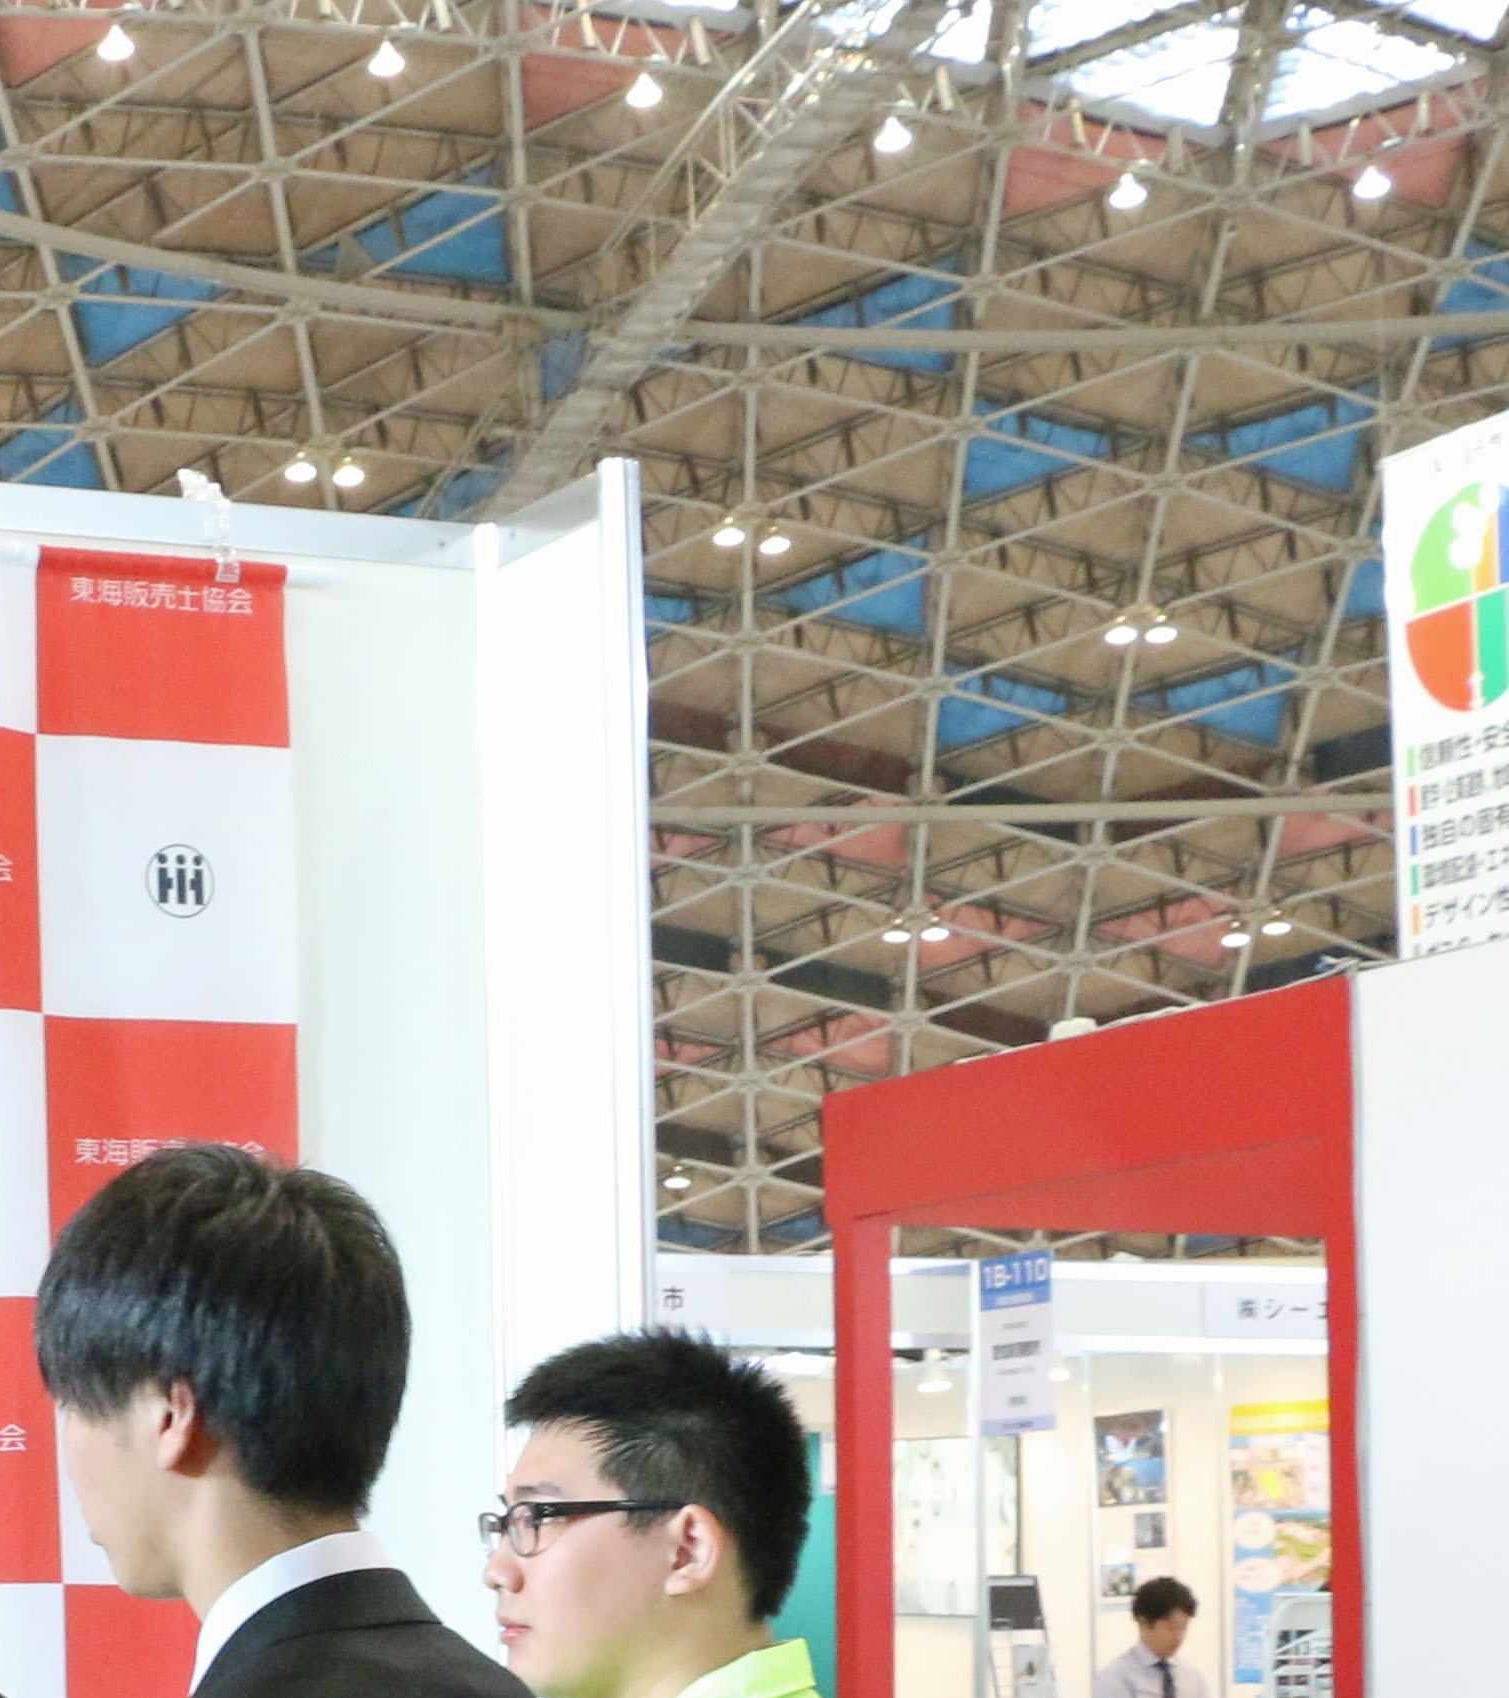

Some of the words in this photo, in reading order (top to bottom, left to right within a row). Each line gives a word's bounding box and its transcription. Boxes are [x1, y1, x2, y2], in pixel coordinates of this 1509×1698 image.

[70, 576, 254, 615] 東海販売士協会
